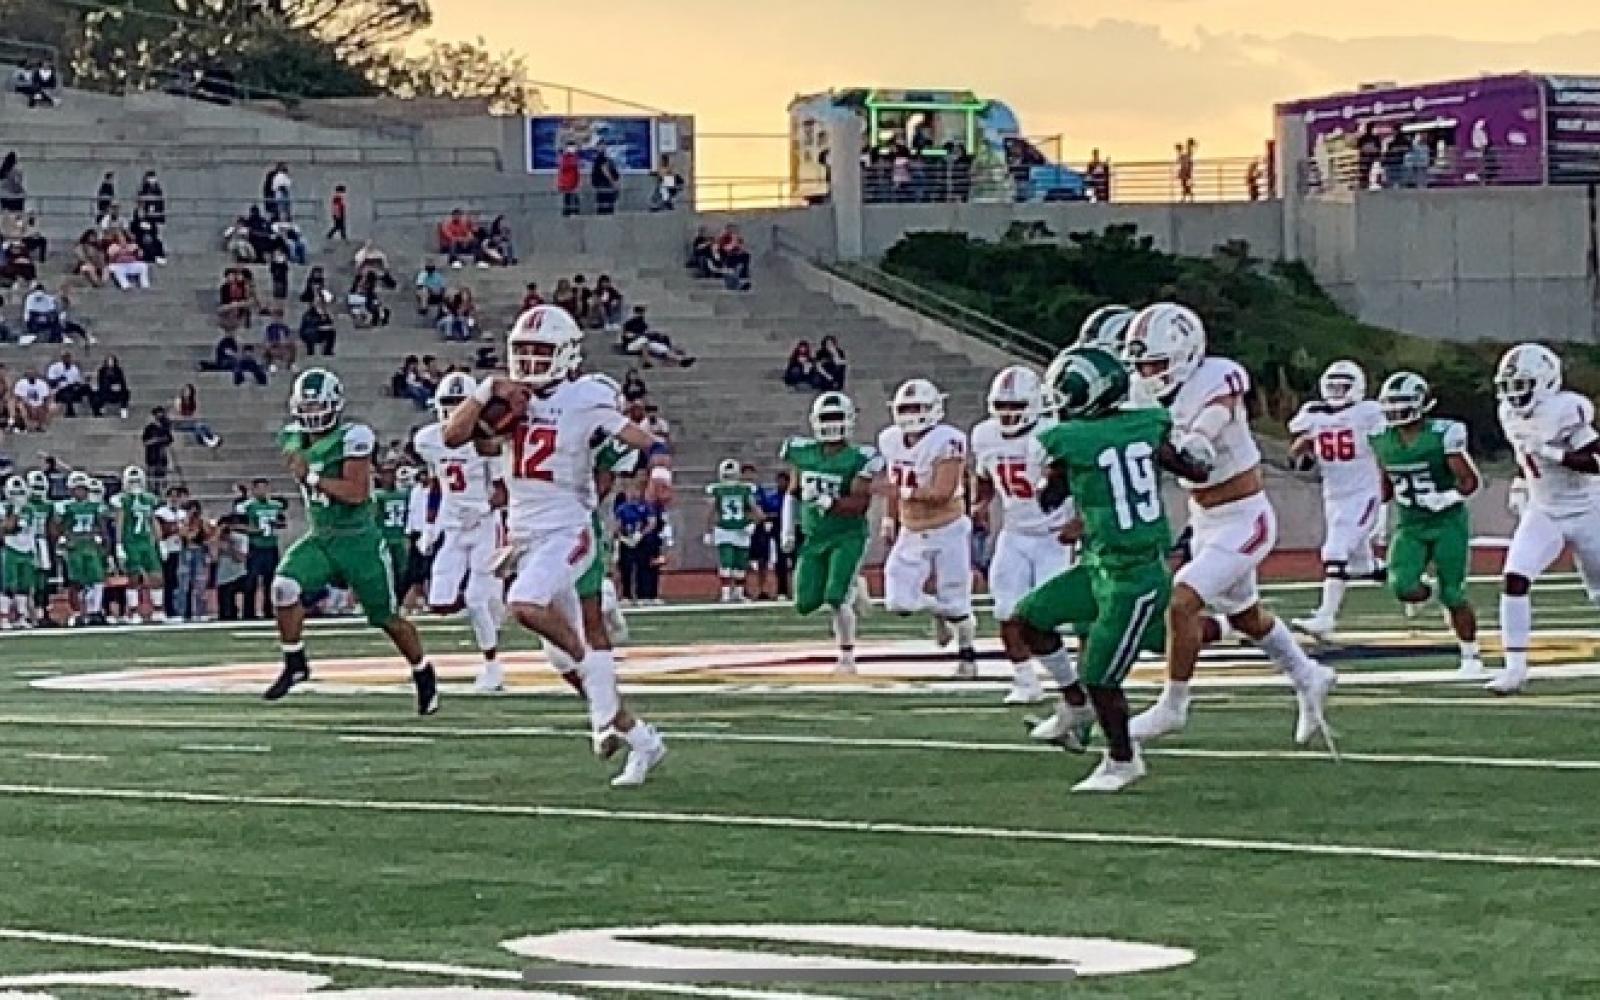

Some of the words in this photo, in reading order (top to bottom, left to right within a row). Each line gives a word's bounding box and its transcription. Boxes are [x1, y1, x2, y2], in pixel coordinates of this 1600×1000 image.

[511, 426, 558, 482] 12
[1319, 429, 1355, 462] 66
[446, 464, 467, 492] 3
[996, 463, 1033, 498] 15
[1098, 441, 1161, 530] 19
[1389, 471, 1437, 507] 25
